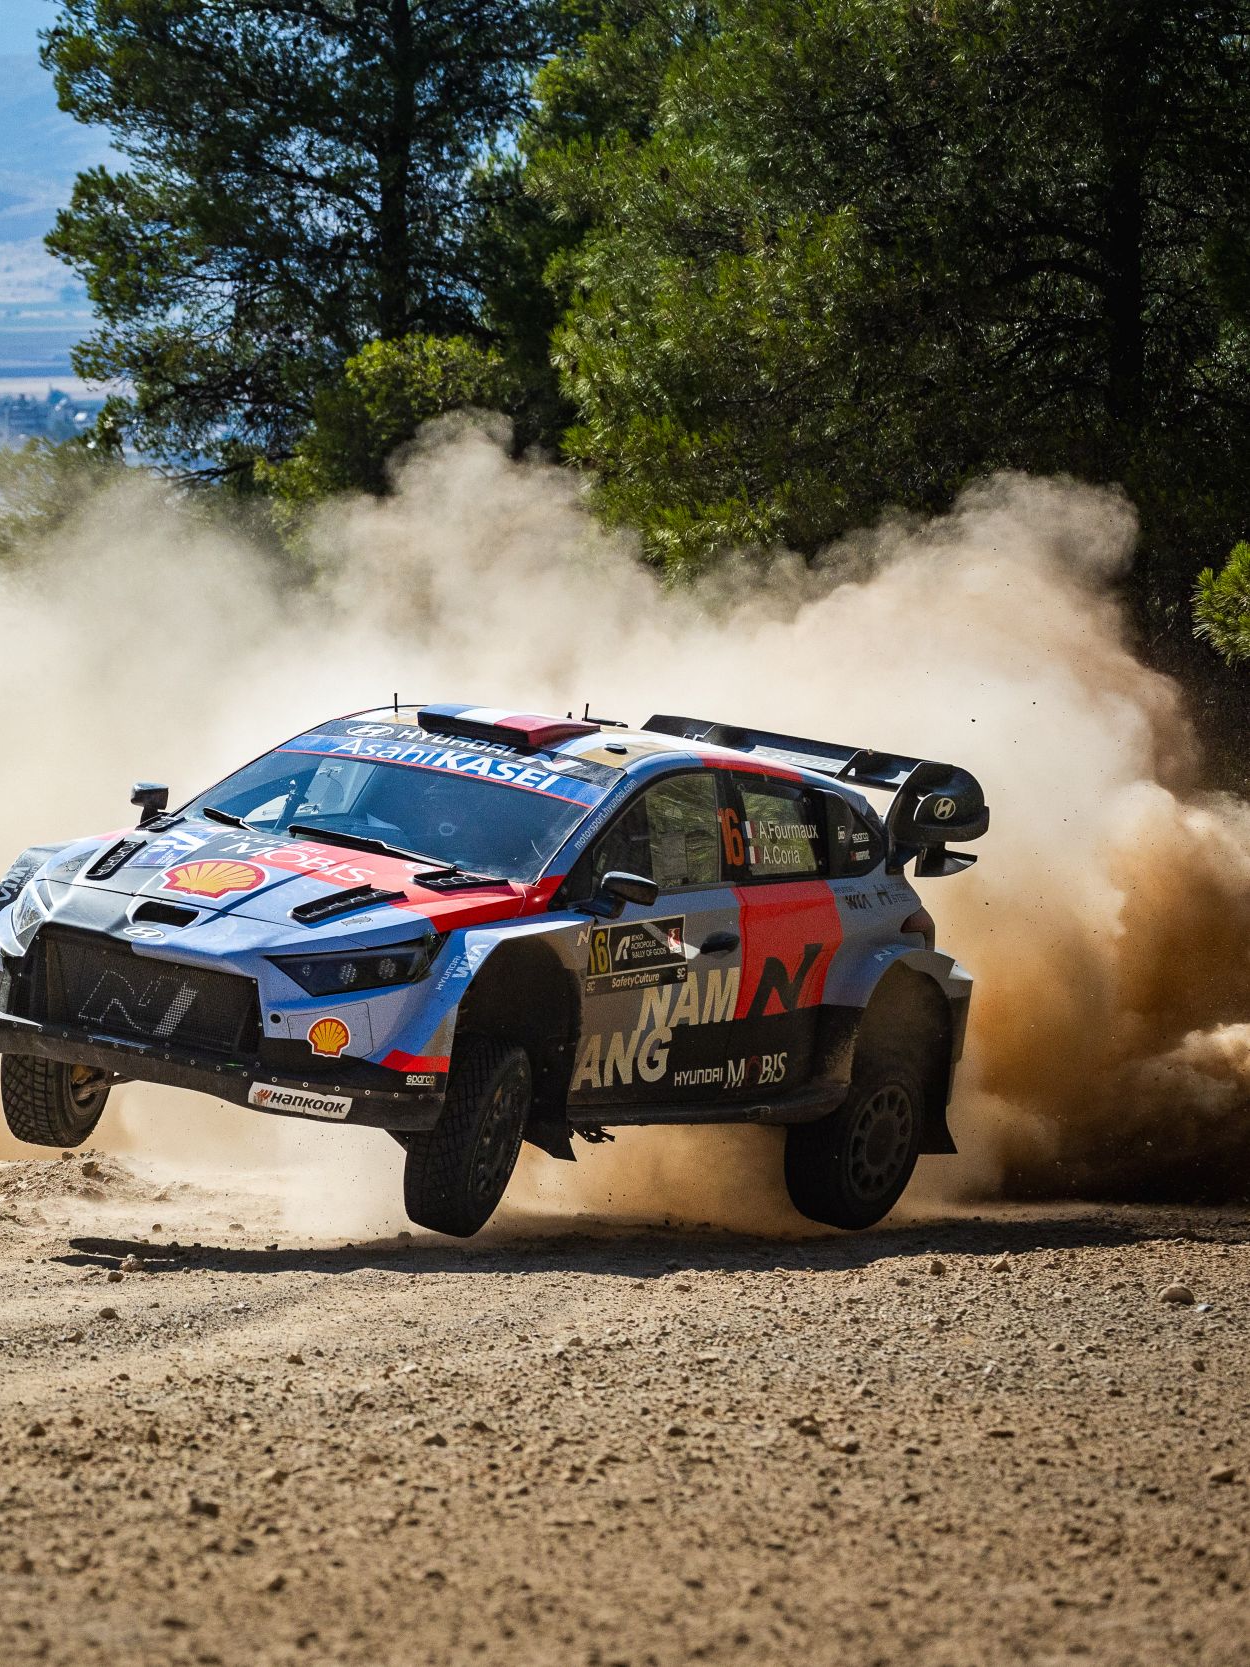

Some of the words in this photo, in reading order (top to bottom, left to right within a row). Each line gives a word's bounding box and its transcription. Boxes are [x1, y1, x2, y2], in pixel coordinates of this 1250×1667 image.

[330, 739, 563, 790] AsahiKASEI
[574, 779, 638, 850] motorsport.hyundai.com
[224, 833, 327, 854] HYUNDAI
[717, 807, 745, 866] 16
[220, 842, 376, 883] MOBIS
[763, 846, 800, 864] A.Coria
[630, 940, 656, 950] ACROPOLIS
[631, 950, 646, 959] RALLY
[646, 949, 653, 957] OF
[653, 947, 667, 956] GODS
[435, 955, 462, 990] HYUNDAI
[612, 972, 660, 988] SafetyCulture
[637, 966, 741, 1032] NAM
[405, 1074, 436, 1086] sparco
[674, 1067, 724, 1087] HYUNDAI
